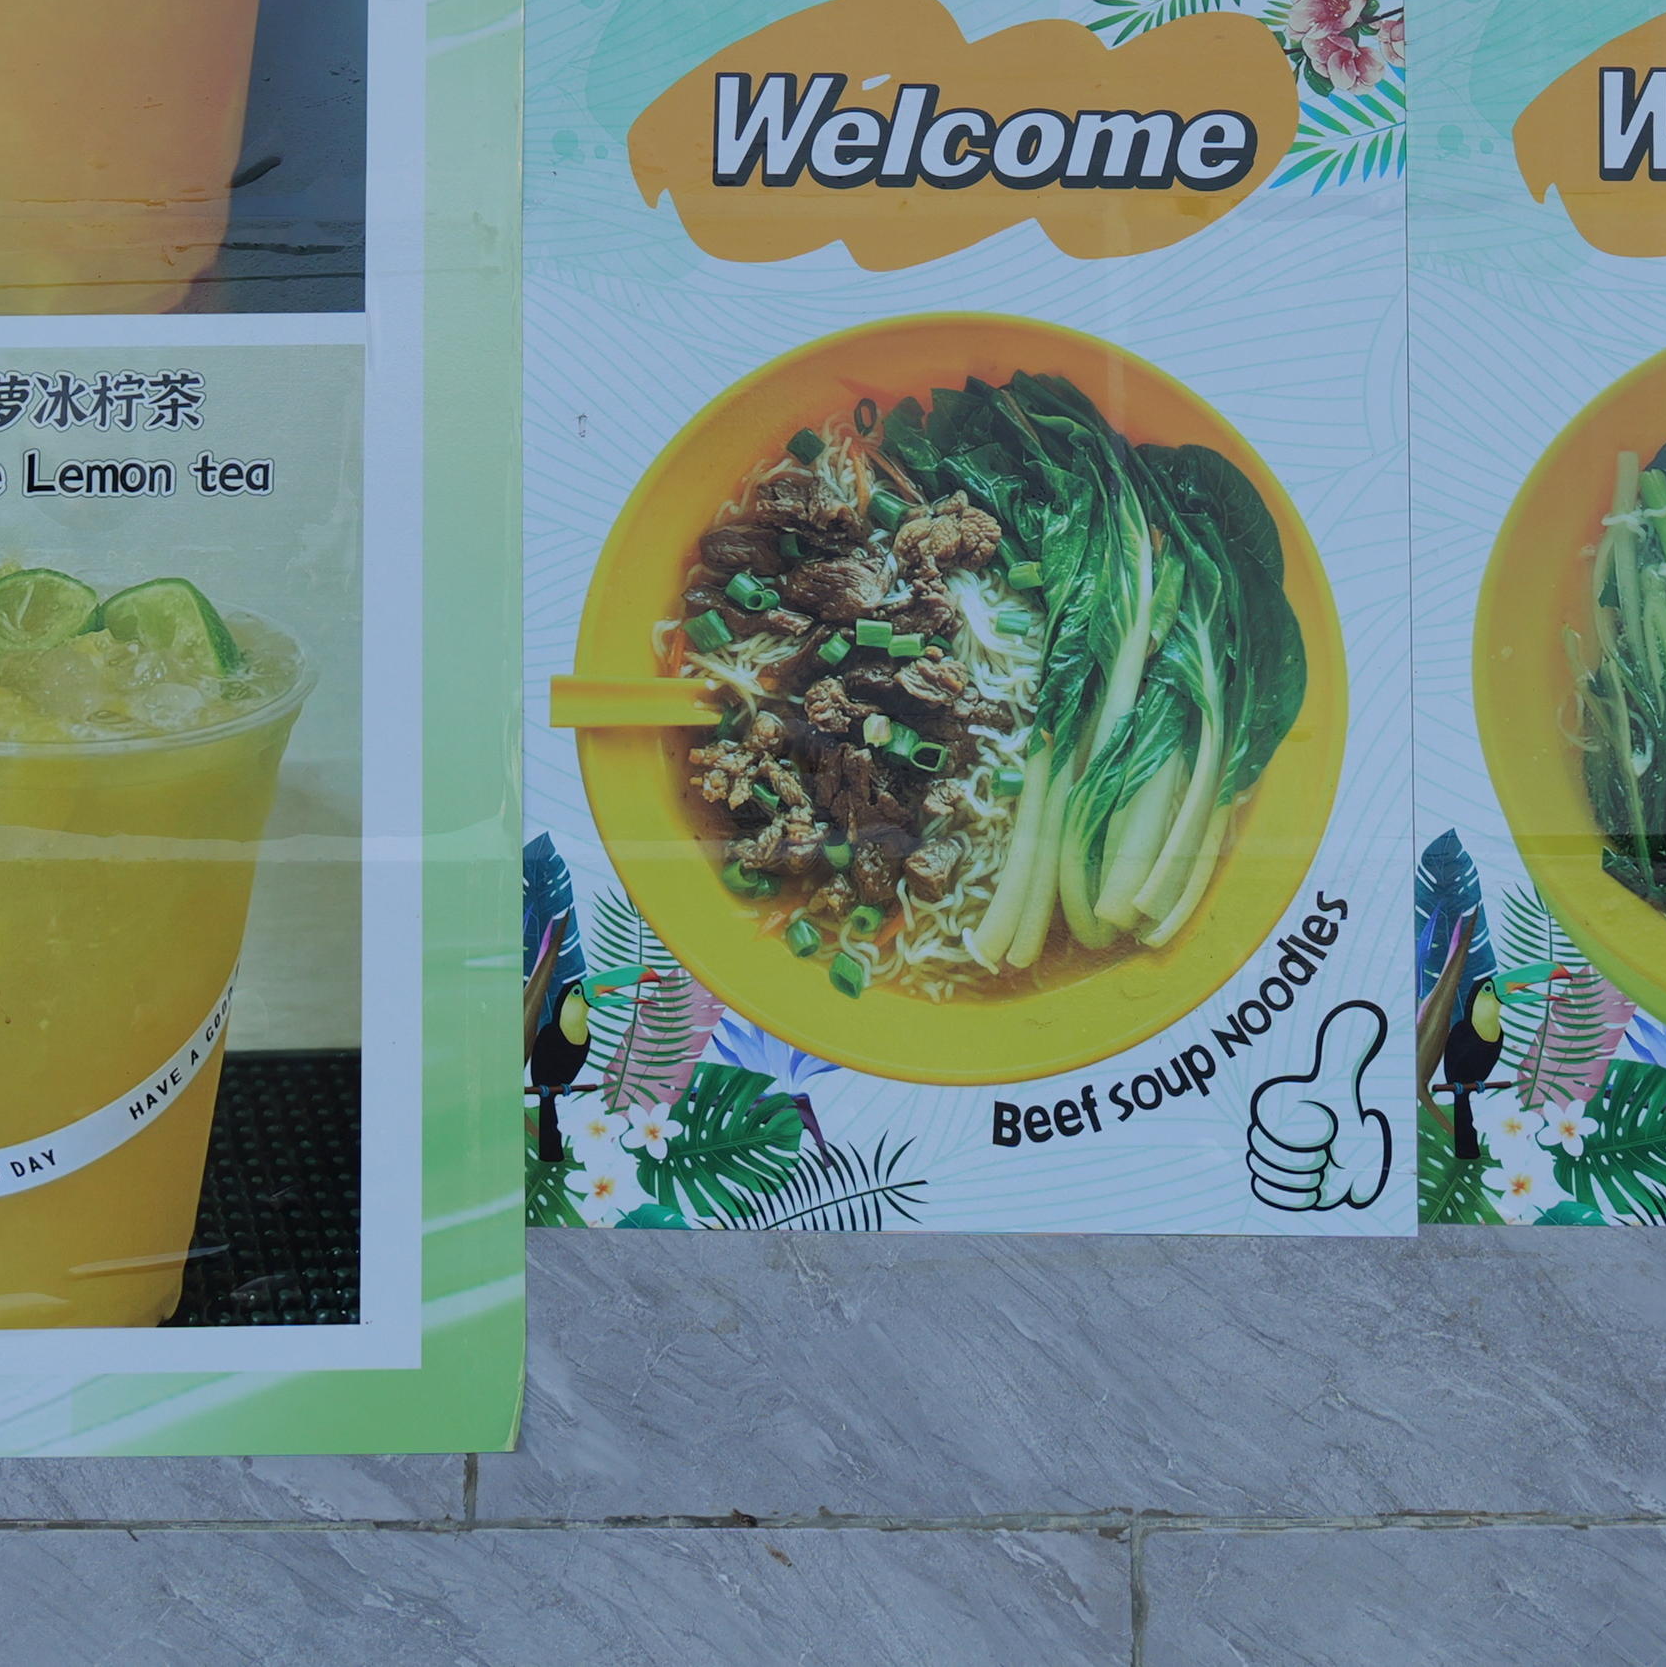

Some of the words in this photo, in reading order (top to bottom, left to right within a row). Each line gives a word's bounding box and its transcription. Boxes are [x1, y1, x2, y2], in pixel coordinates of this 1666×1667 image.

[713, 72, 1258, 191] Welcome
[24, 454, 173, 496] Lemon
[193, 455, 273, 494] tea
[992, 1084, 1102, 1148] Beef
[1211, 891, 1348, 1058] Noodles
[129, 1067, 182, 1120] HAVE
[190, 1049, 199, 1065] A
[10, 1149, 56, 1178] DAY
